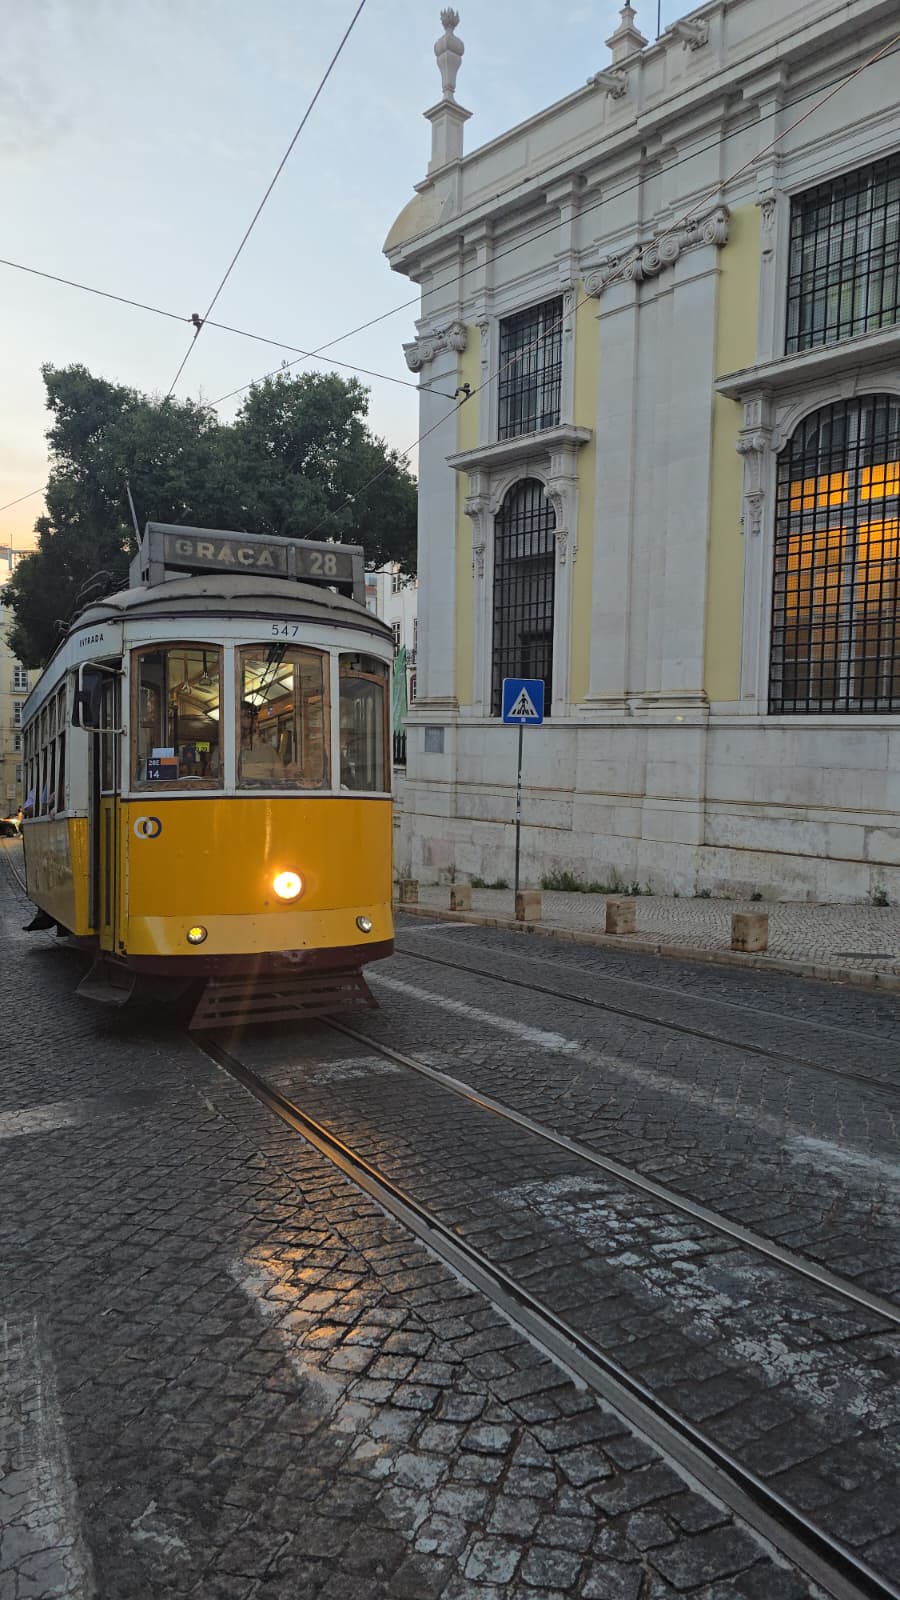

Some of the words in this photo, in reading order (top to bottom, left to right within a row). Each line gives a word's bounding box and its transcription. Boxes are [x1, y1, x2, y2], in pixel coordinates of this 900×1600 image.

[175, 539, 274, 566] GRAÇA
[310, 552, 337, 576] 28
[272, 624, 299, 637] 547
[148, 770, 160, 779] 14
